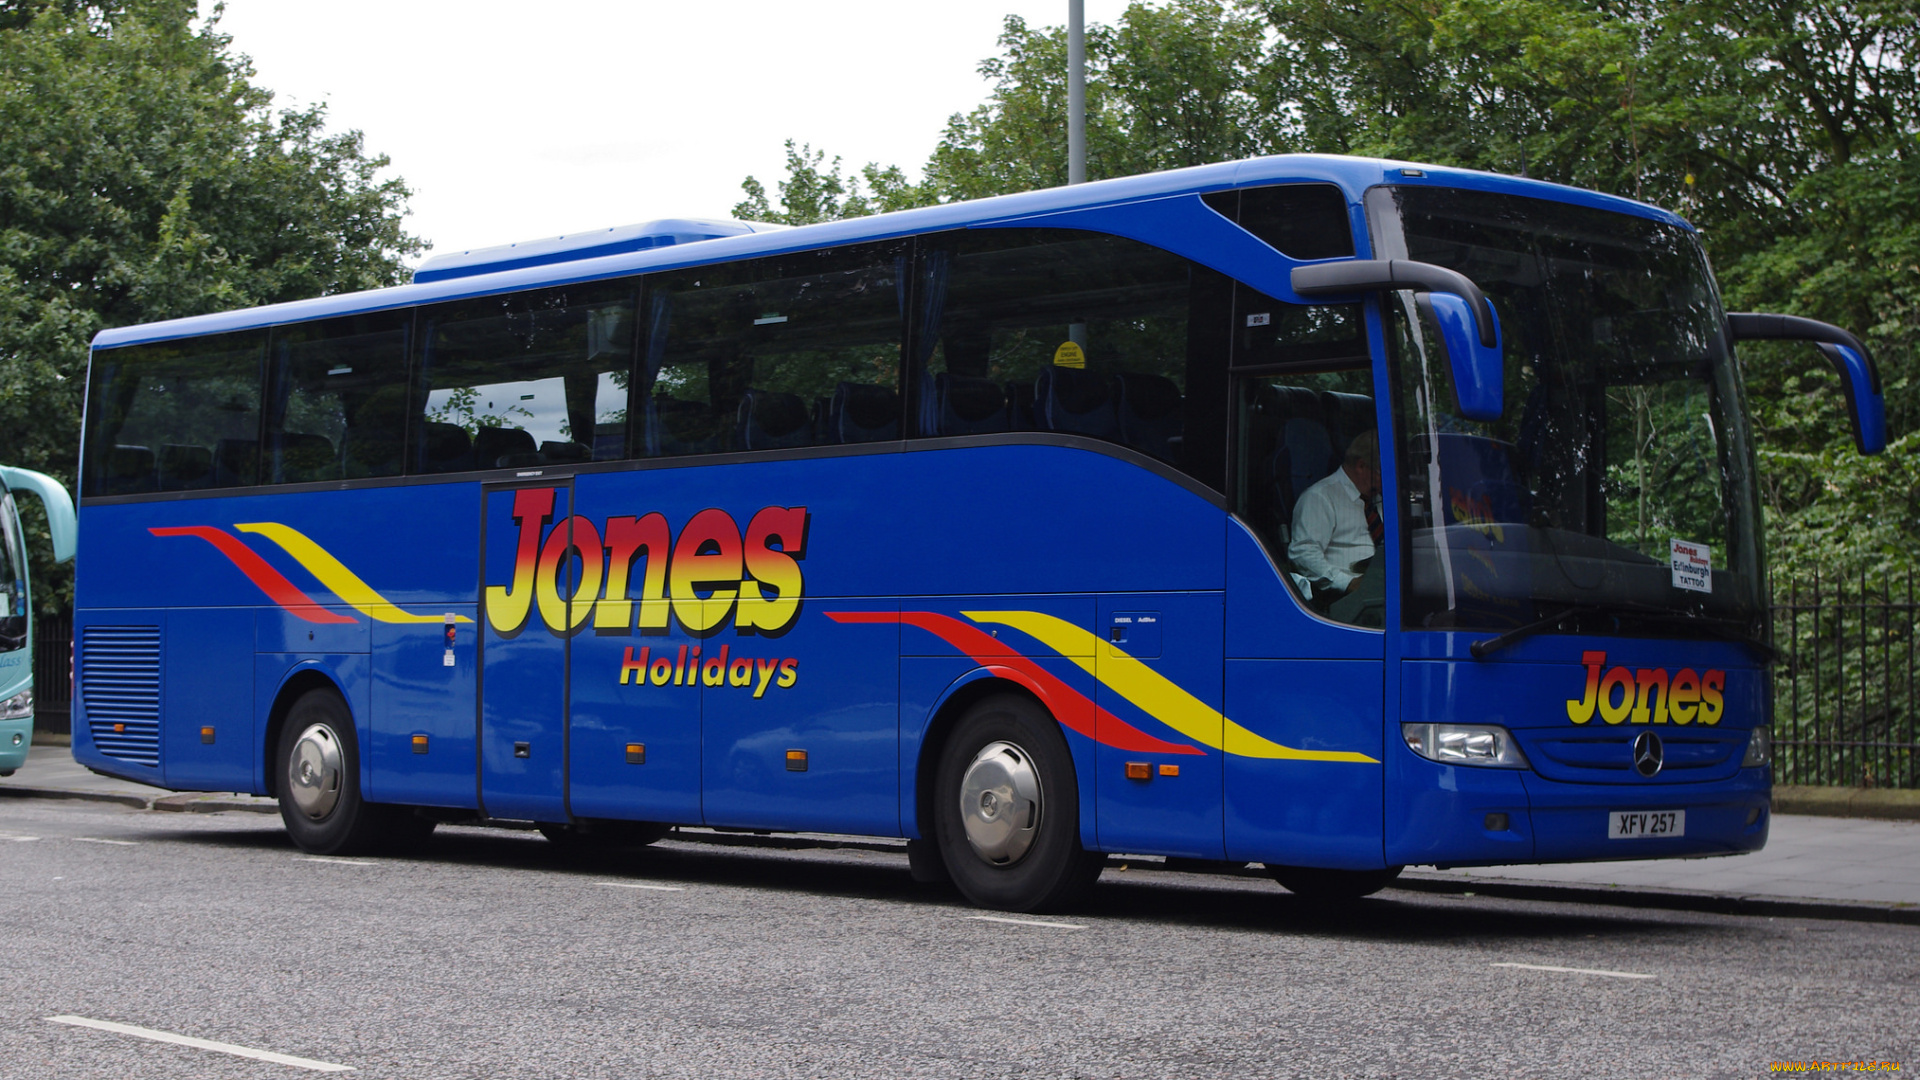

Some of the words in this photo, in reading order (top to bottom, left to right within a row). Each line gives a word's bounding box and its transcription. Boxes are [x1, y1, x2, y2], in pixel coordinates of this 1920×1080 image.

[485, 487, 810, 638] Jones
[1673, 543, 1697, 556] Jones
[1679, 576, 1705, 588] TATTOO
[619, 644, 799, 699] Holidays
[1566, 650, 1726, 727] Jones
[1620, 813, 1647, 834] XFV
[1650, 813, 1676, 833] 257
